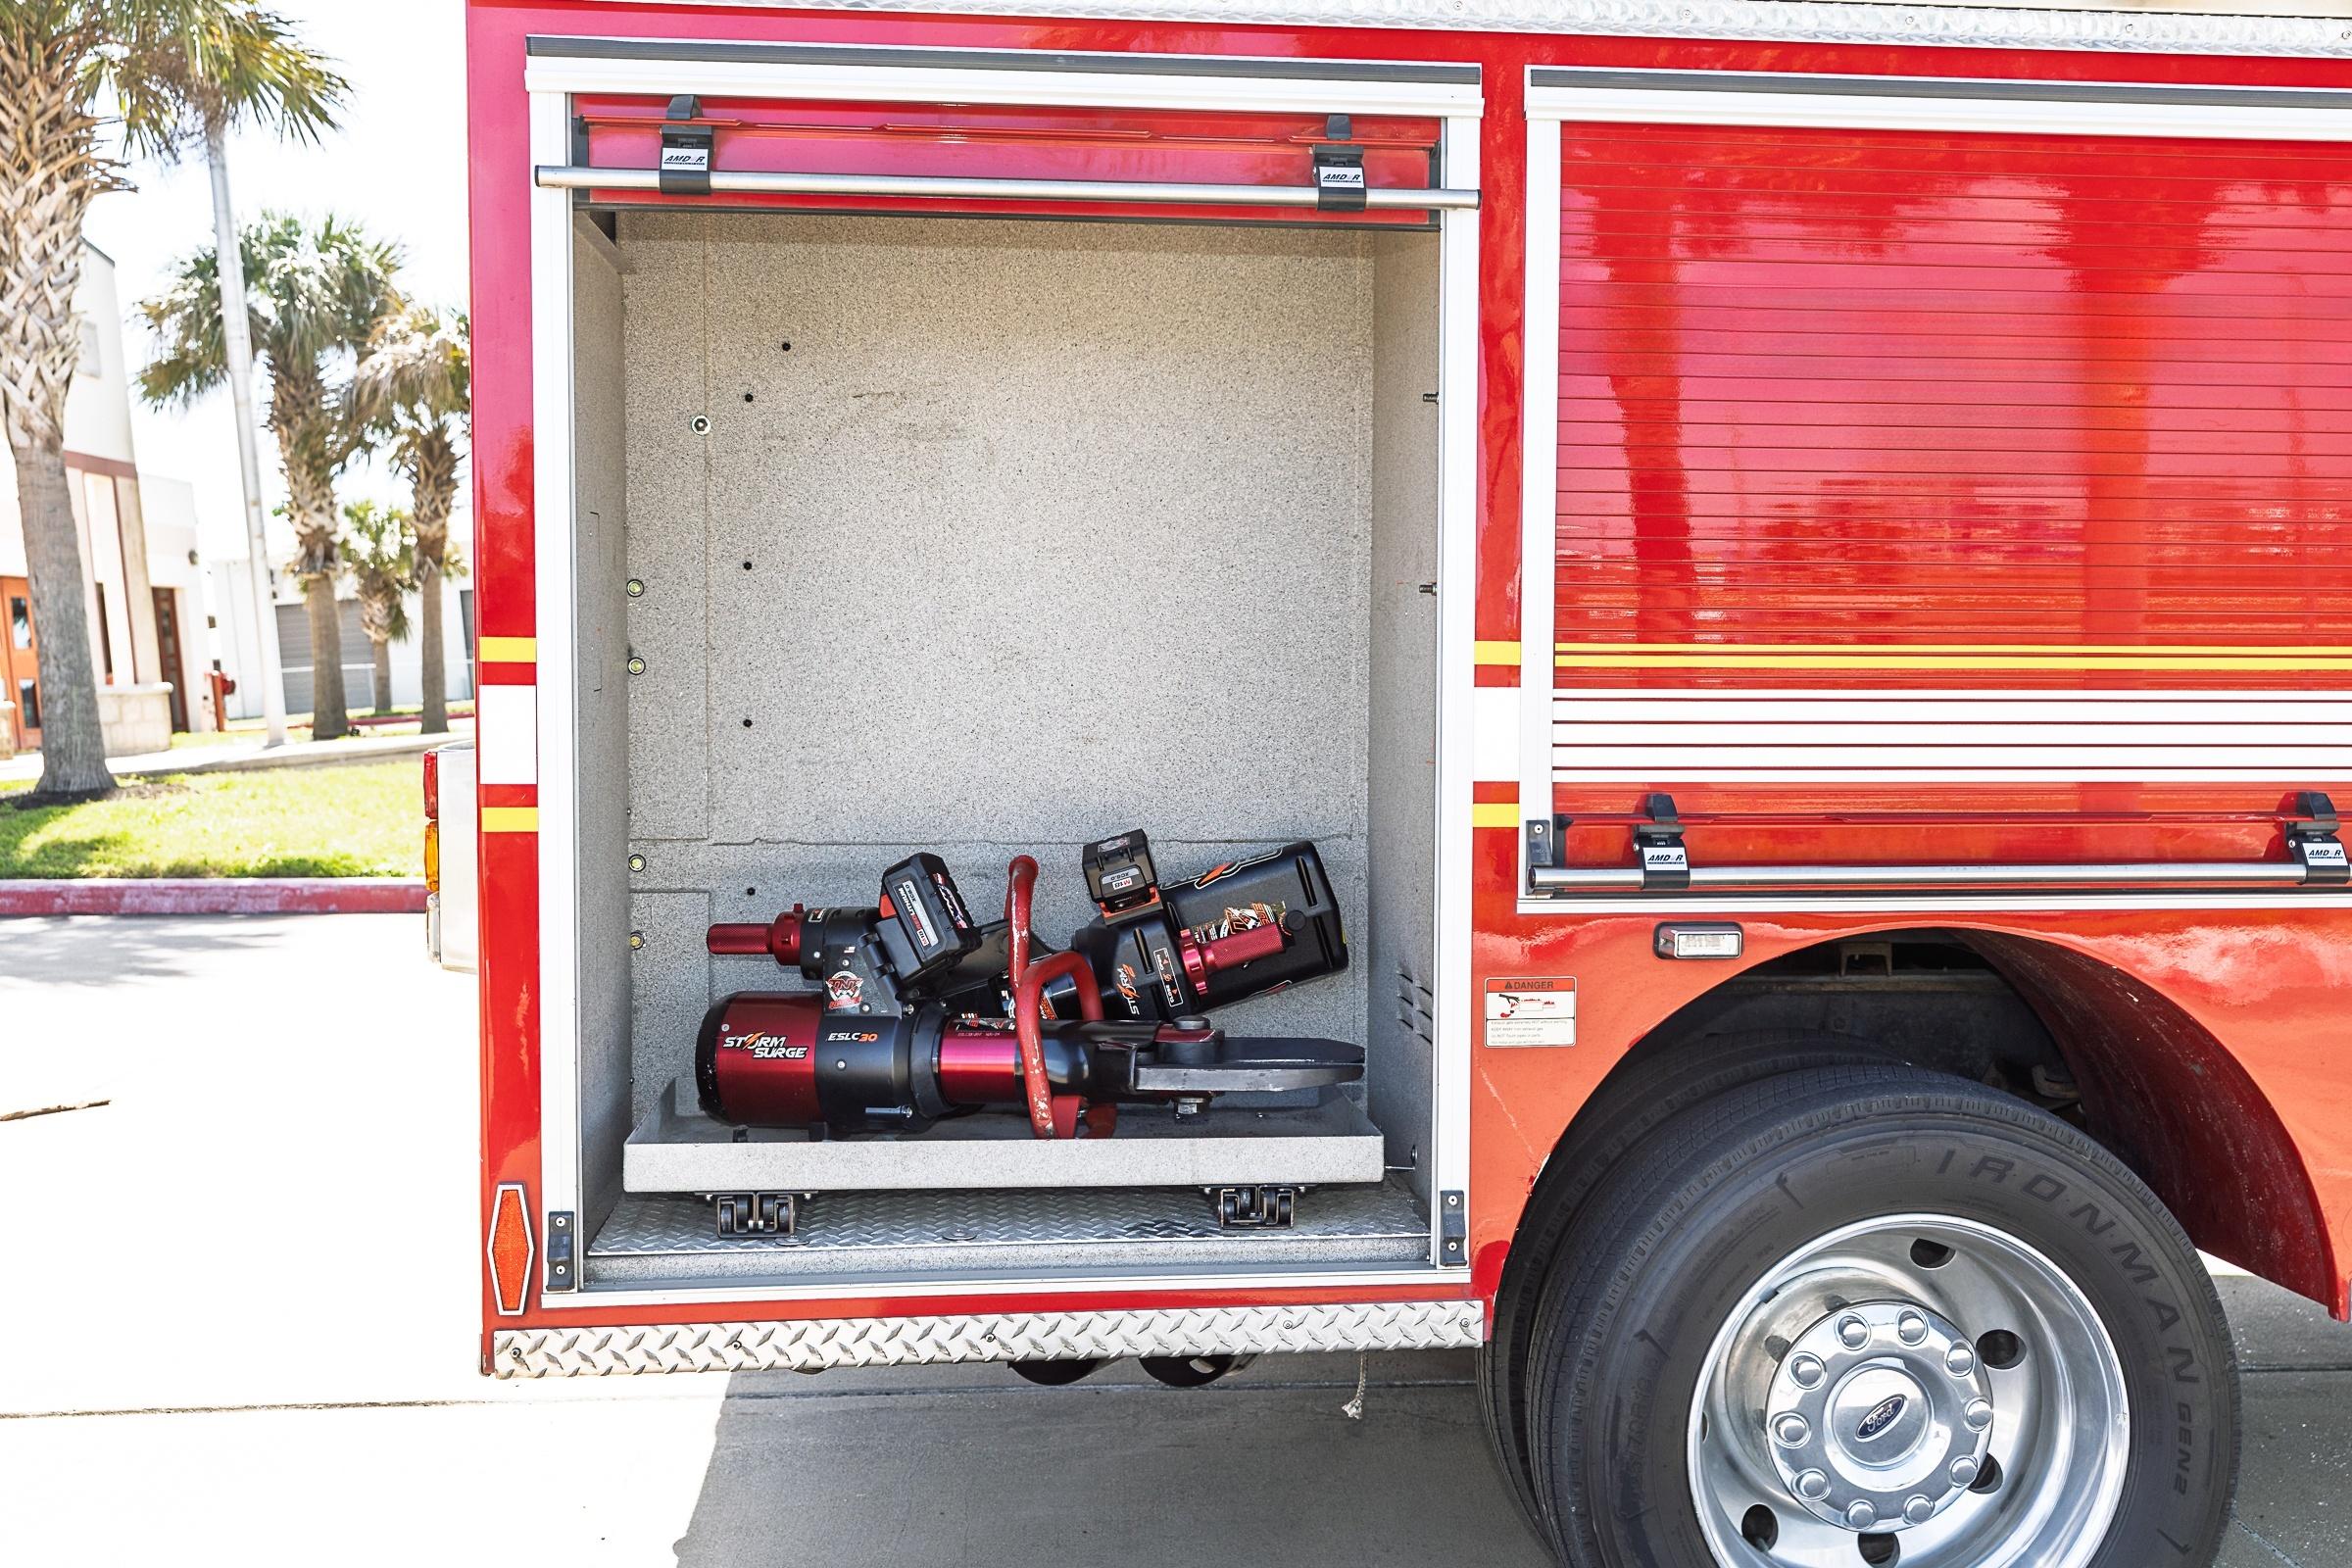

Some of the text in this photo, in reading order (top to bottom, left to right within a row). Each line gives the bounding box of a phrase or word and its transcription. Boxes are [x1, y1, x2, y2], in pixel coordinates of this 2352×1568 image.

[1113, 878, 1132, 889] M18
[827, 977, 863, 991] TNT
[1117, 967, 1141, 1015] STORM
[1513, 981, 1554, 990] DANGER
[722, 1031, 787, 1051] STORM
[827, 1032, 879, 1042] ESLC30
[753, 1047, 808, 1059] SURGE
[1936, 1150, 2201, 1384] IRONMAN
[1865, 1402, 1895, 1433] Ford
[2174, 1401, 2192, 1495] GEN2
